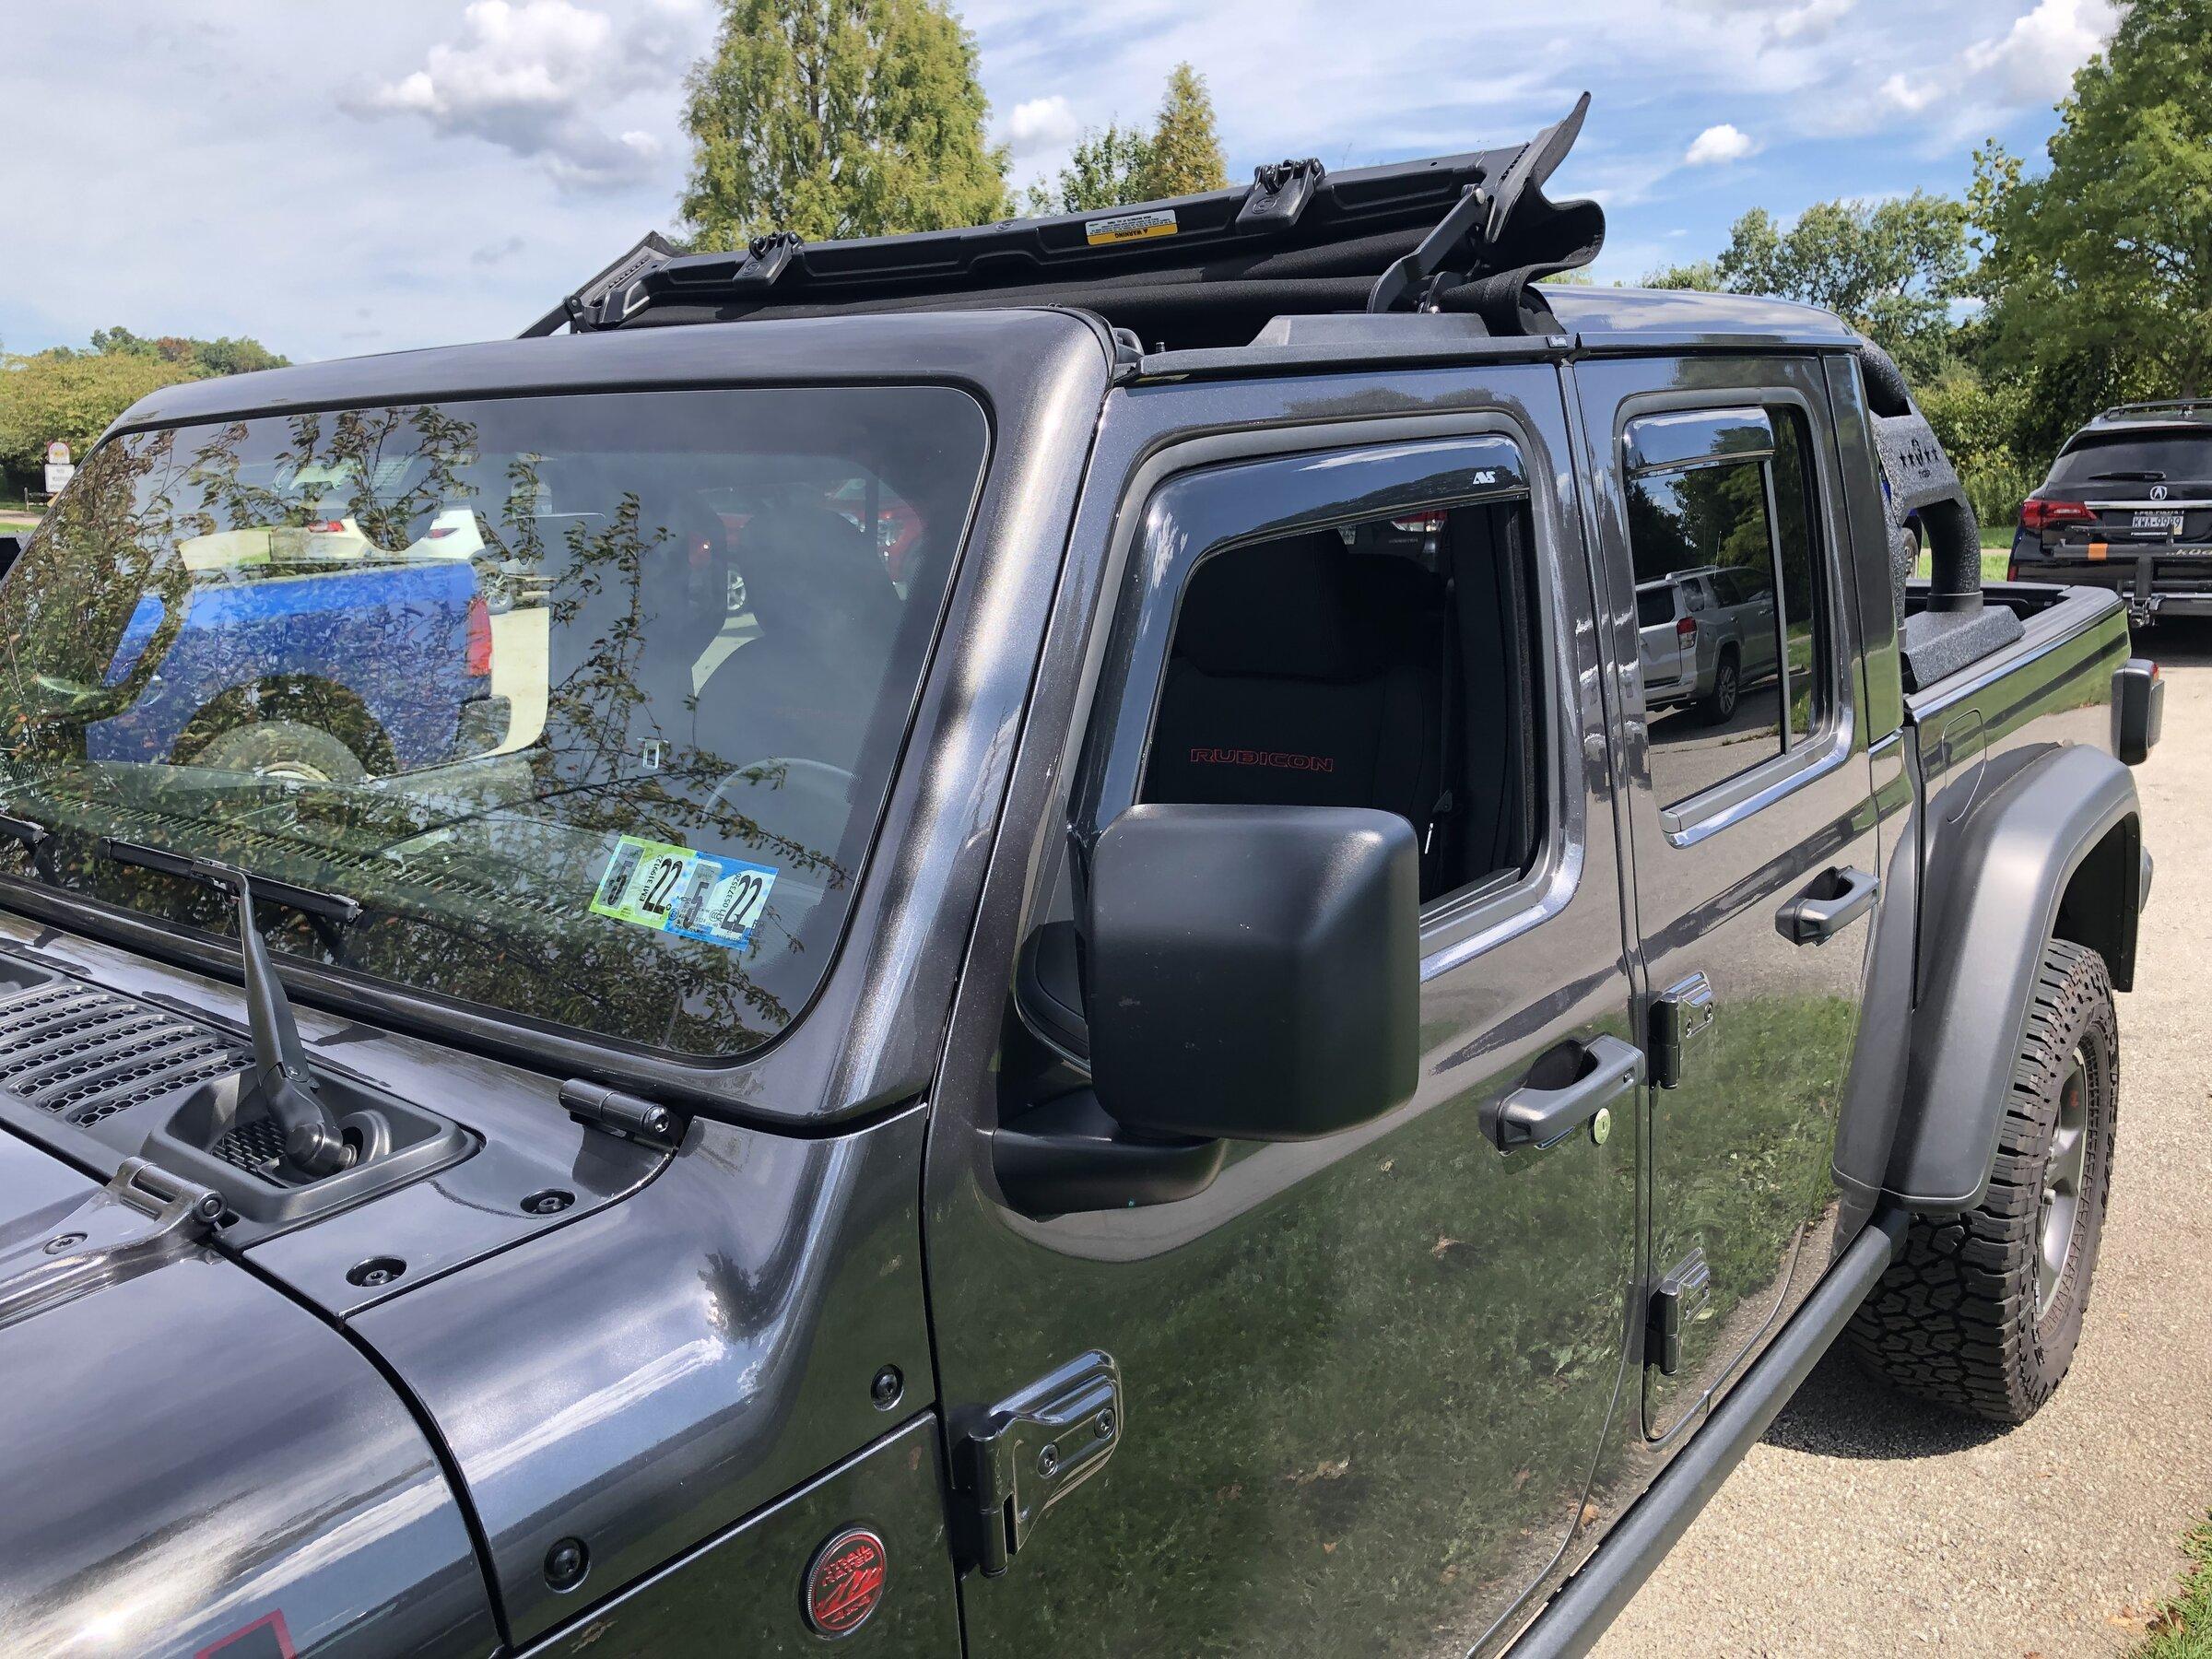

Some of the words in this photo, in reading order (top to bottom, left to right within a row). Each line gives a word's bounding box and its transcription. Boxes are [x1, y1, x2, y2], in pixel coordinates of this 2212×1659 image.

[1114, 230, 1143, 239] WARNING
[1190, 748, 1335, 772] RUBICON
[641, 857, 683, 915] 22
[720, 875, 763, 934] 22
[821, 1549, 876, 1587] RATED
[823, 1545, 874, 1575] TRAIL
